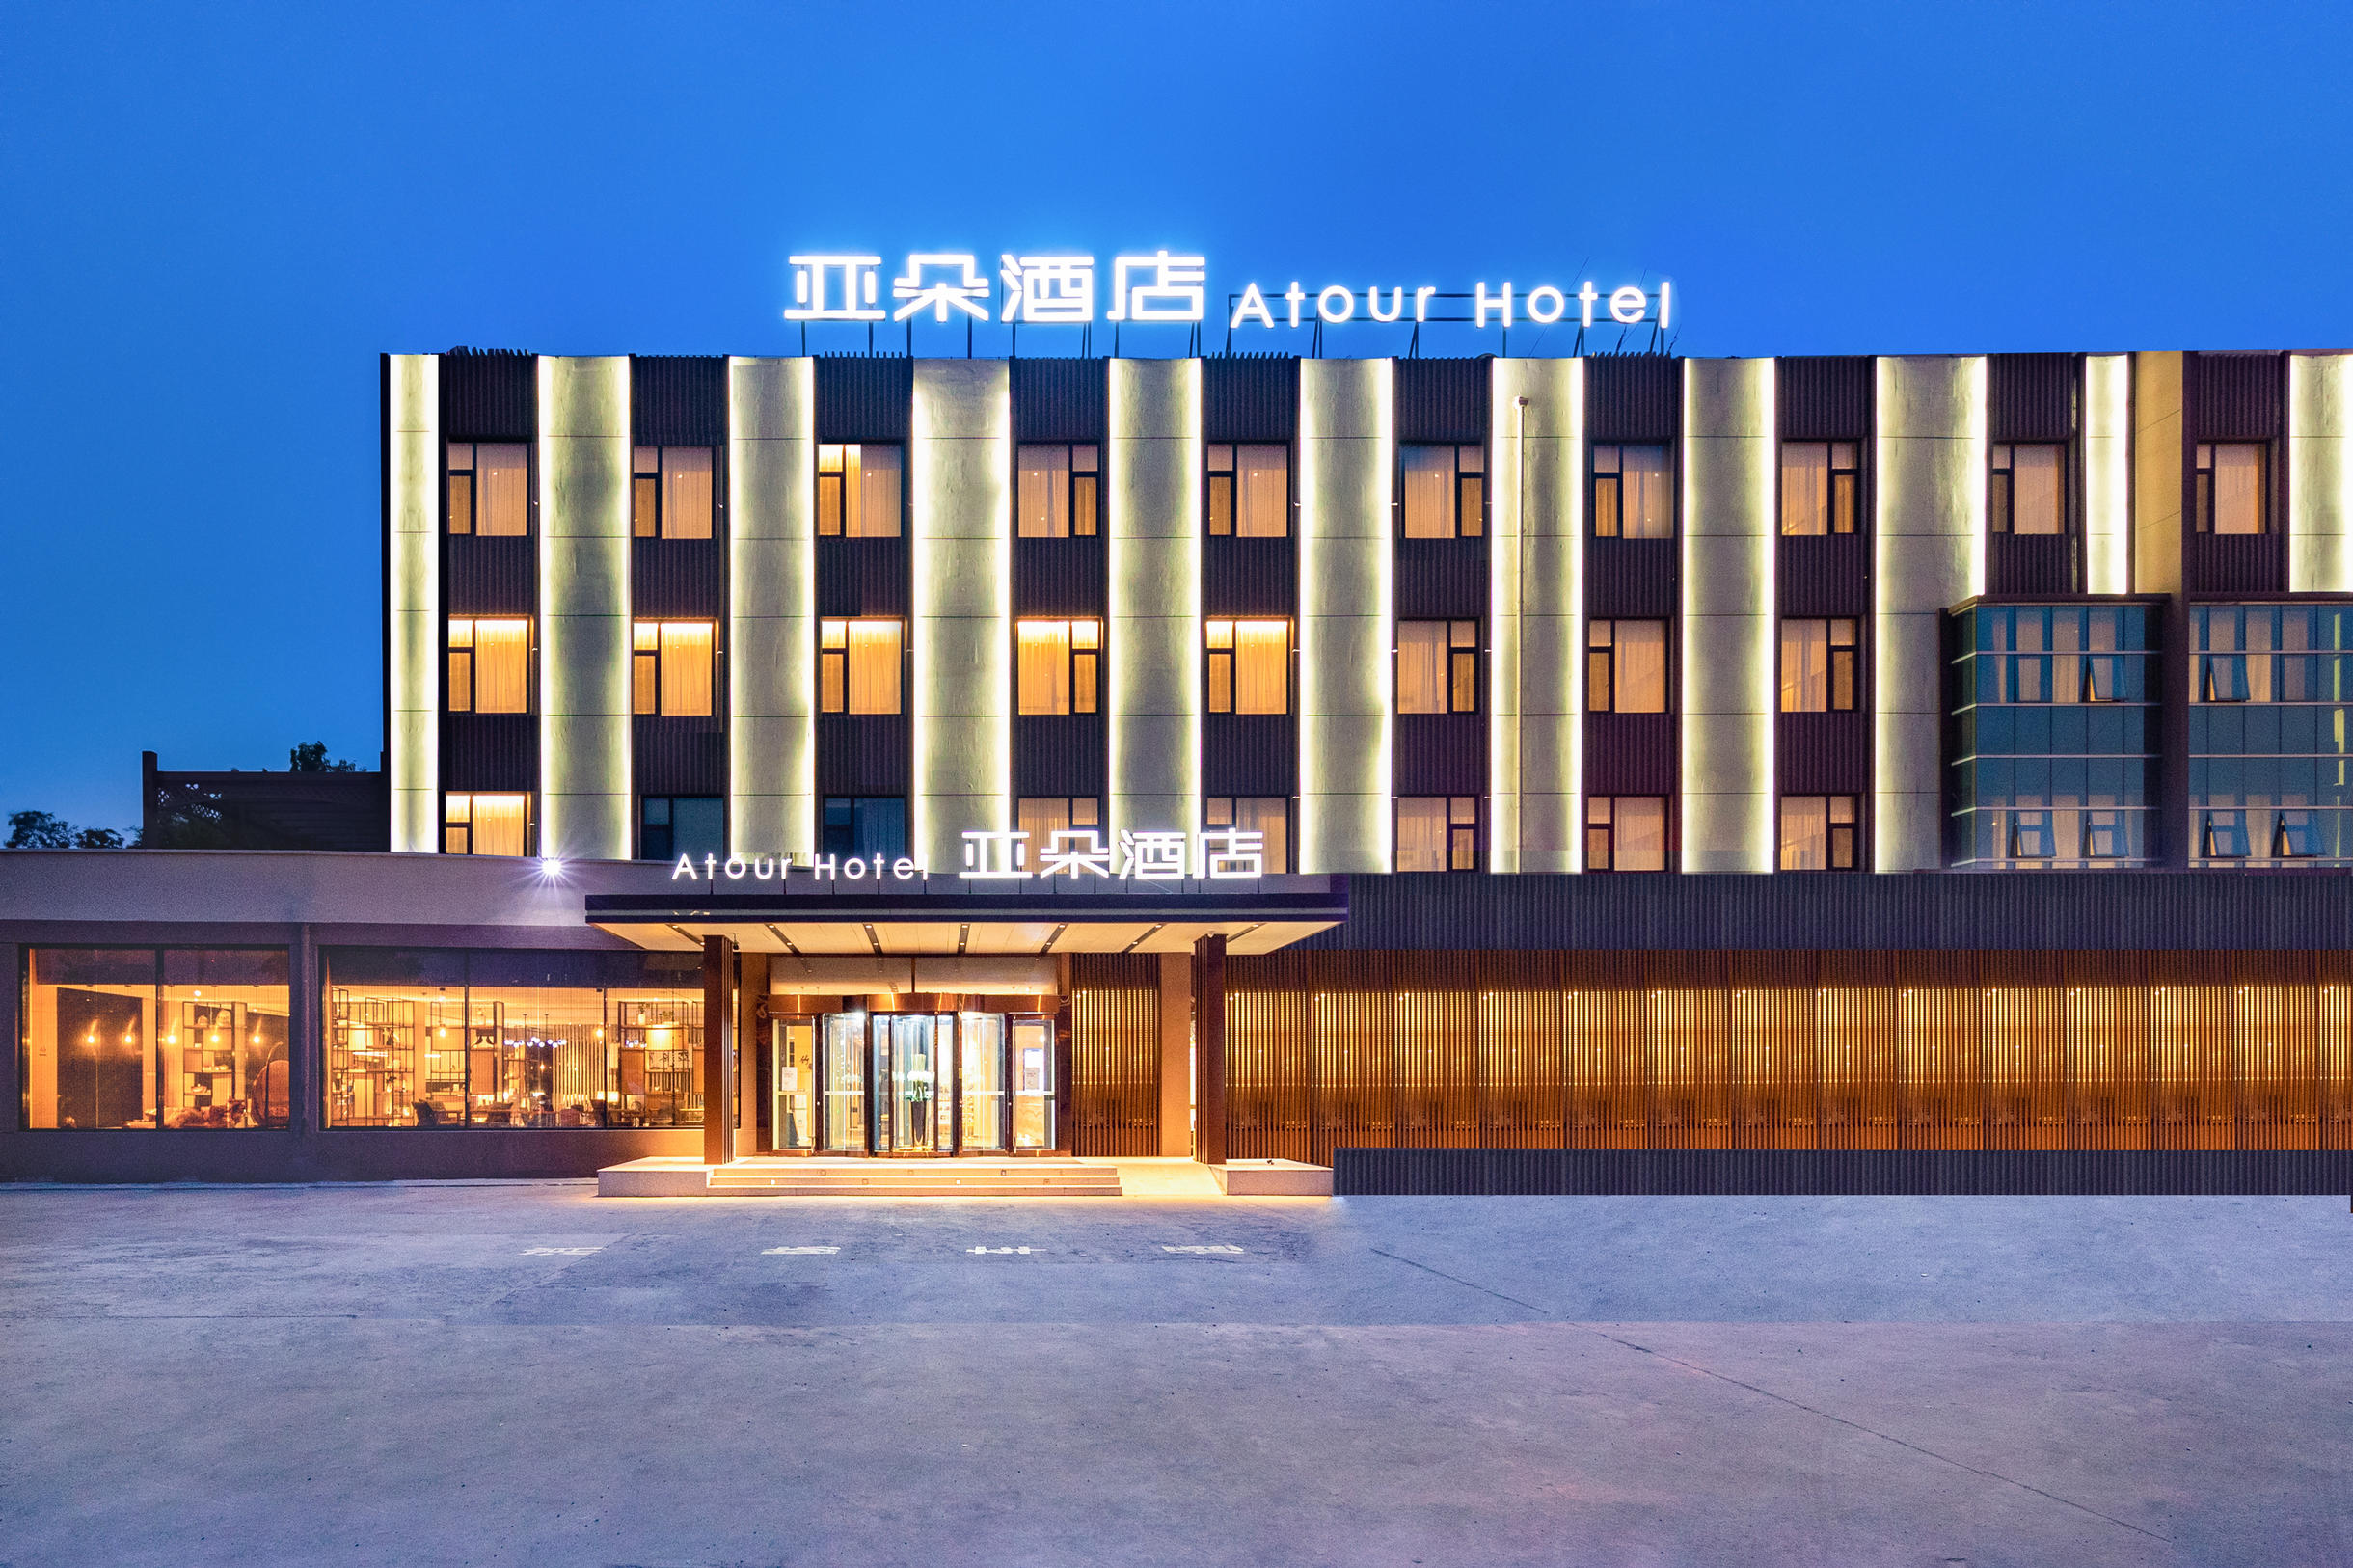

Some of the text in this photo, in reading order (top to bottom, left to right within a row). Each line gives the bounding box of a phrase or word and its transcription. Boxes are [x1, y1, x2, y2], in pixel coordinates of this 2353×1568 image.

[784, 250, 1205, 323] 亚朵酒店
[1230, 281, 1670, 329] Atour Hotel
[671, 852, 929, 881] Atour Hotel
[959, 827, 1264, 879] 亚朵酒店
